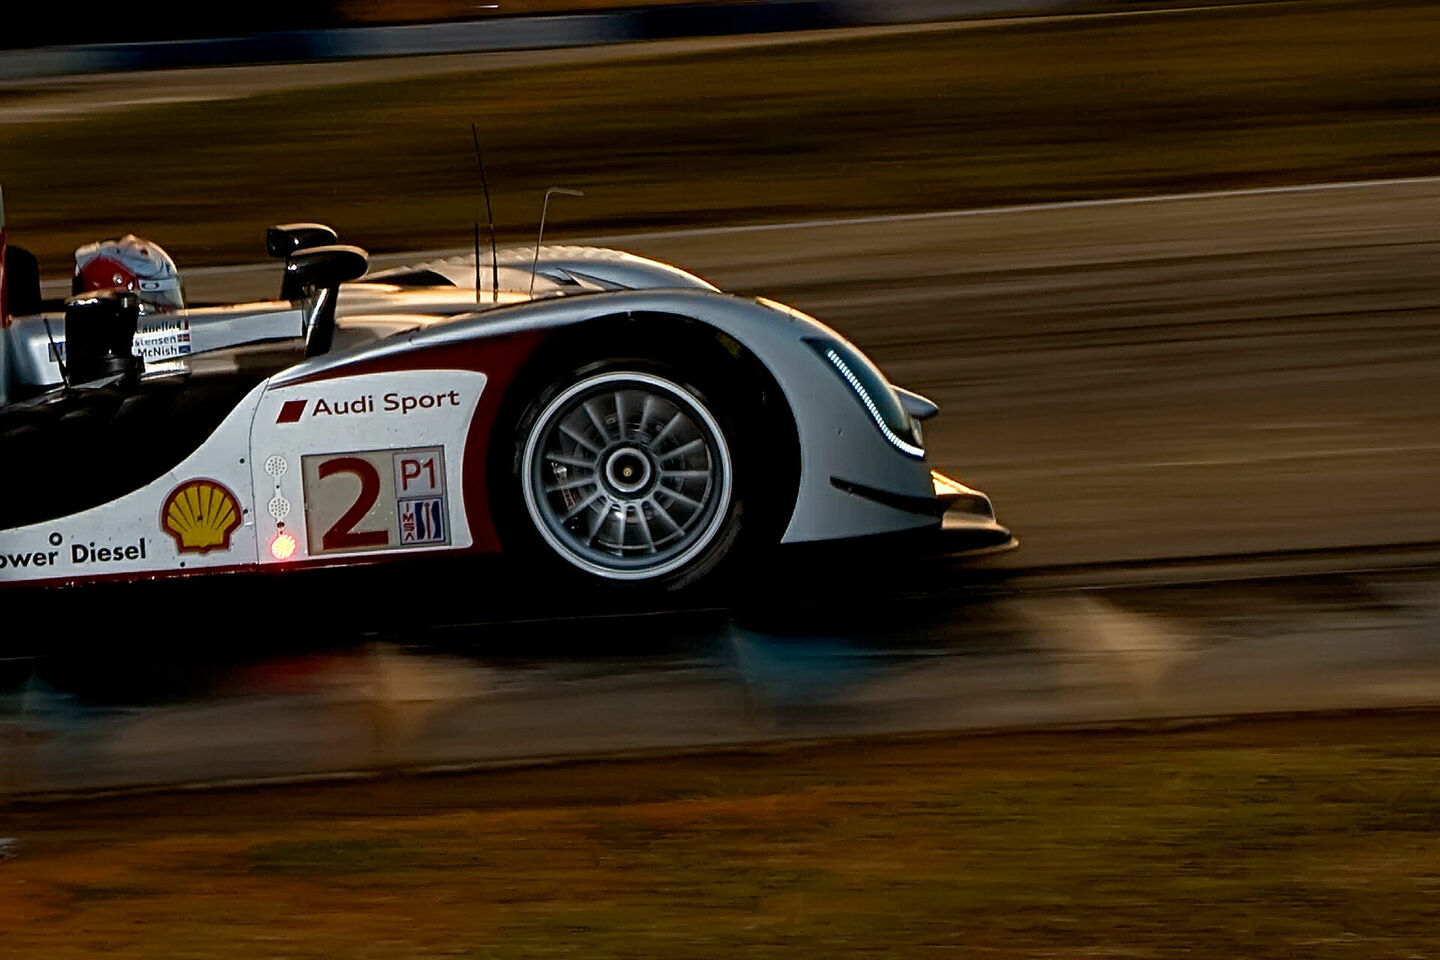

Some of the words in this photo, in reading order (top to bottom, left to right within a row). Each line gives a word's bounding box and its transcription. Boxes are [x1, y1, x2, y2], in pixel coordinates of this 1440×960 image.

[134, 335, 177, 346] stensen
[137, 346, 178, 358] McNish
[312, 396, 374, 416] Audi
[384, 390, 460, 414] Sport
[401, 458, 435, 491] P1
[318, 457, 389, 550] 2
[71, 538, 146, 564] Diesel
